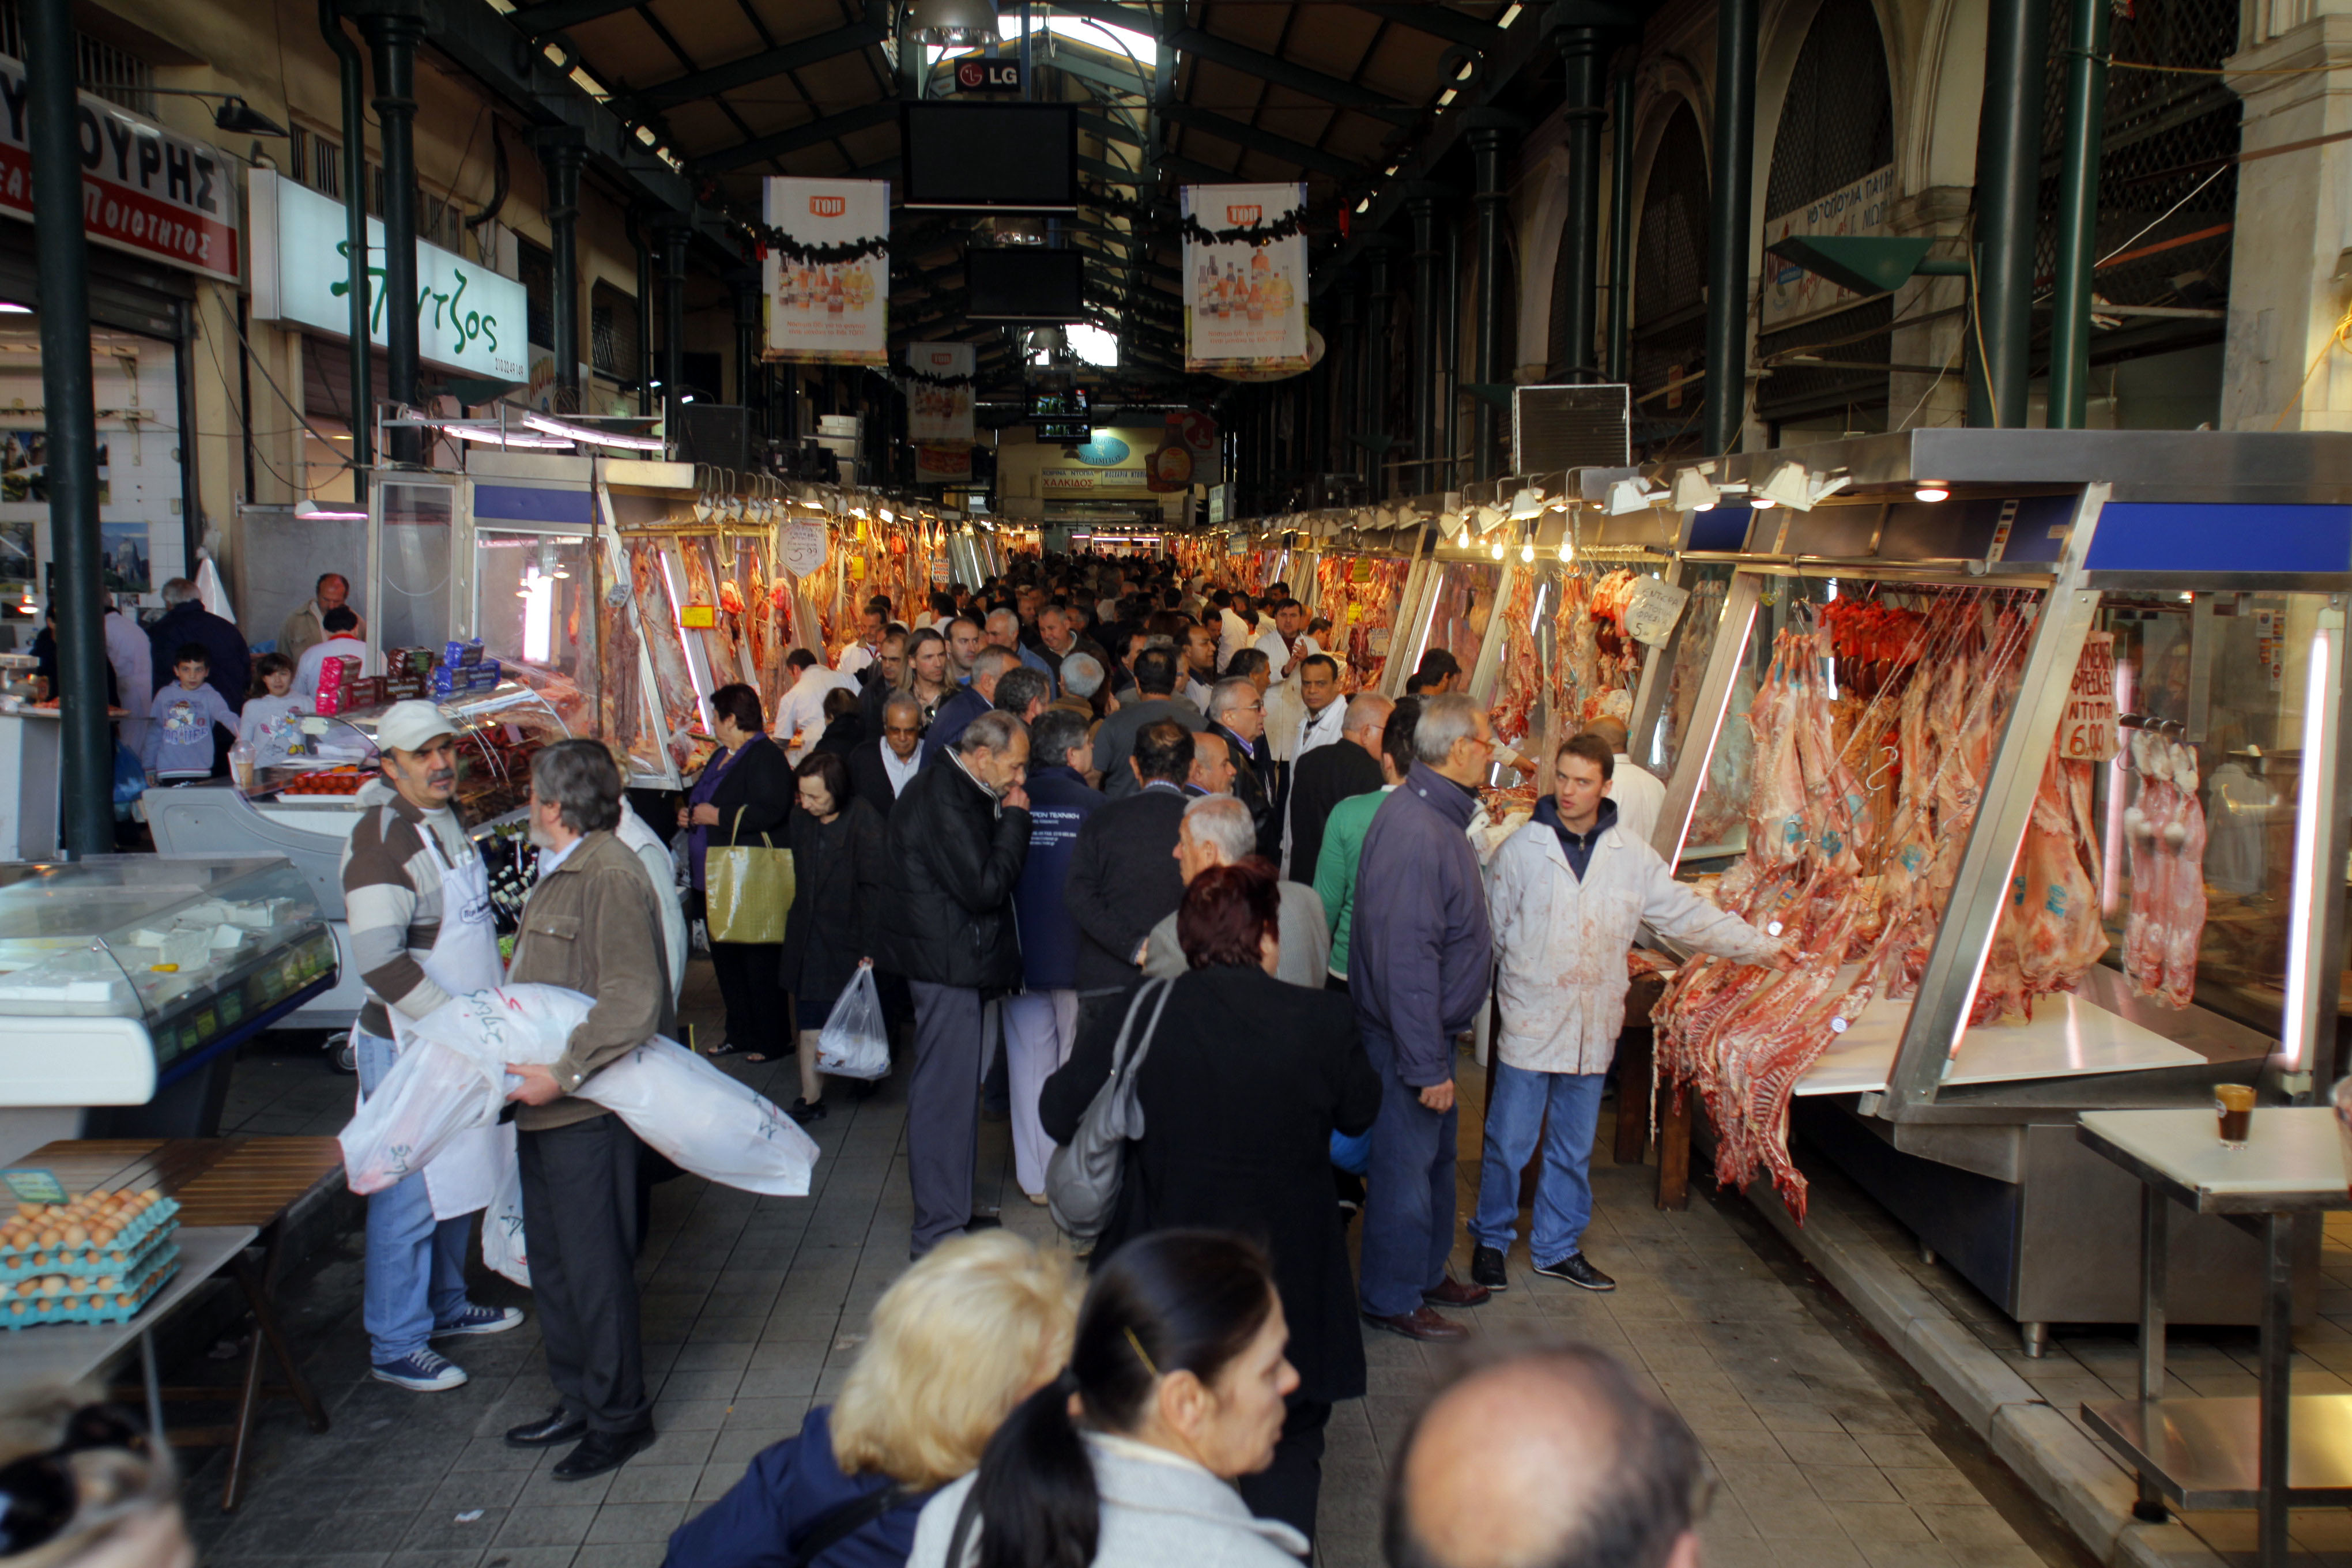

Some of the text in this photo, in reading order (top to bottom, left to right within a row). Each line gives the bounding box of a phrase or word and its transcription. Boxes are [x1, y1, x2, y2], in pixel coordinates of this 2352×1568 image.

[990, 67, 1017, 84] LG
[812, 198, 842, 214] ΤΟΠ
[84, 180, 211, 261] ΠΟΙΟΤΗΤΟΣ
[1043, 478, 1094, 488] ΧΑΛΚΙΔΟΣ
[2068, 701, 2113, 721] ΝΤΟΠΙΑ
